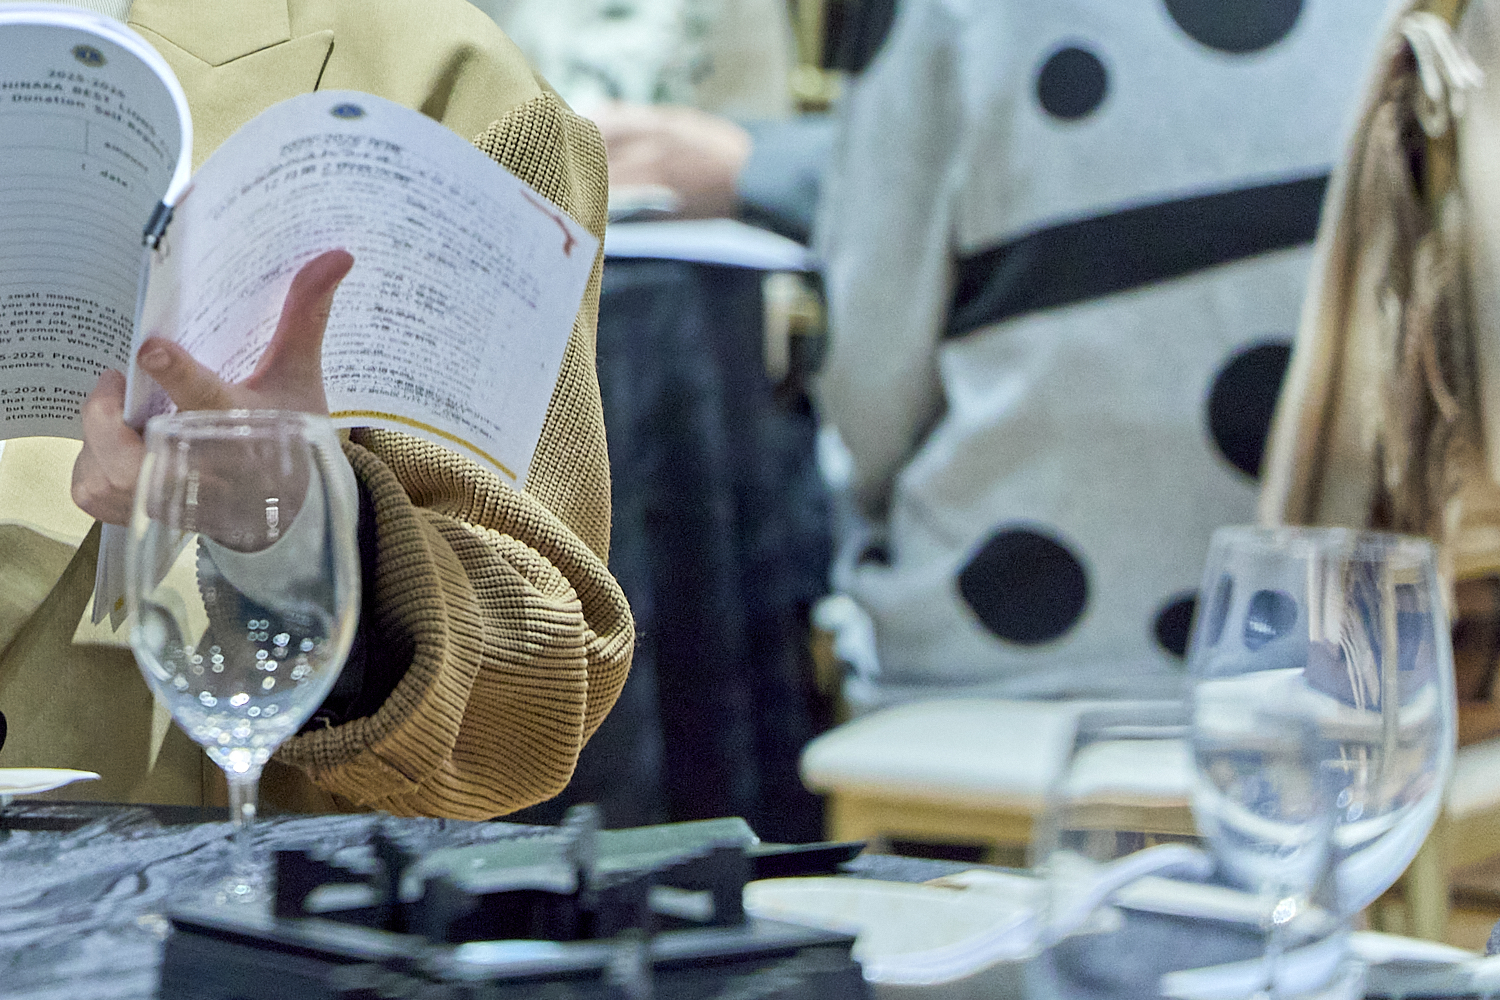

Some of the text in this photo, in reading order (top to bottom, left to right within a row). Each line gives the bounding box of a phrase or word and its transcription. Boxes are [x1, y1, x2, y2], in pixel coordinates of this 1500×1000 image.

[11, 93, 85, 108] Donation
[8, 291, 40, 300] small
[45, 292, 99, 309] moments
[1, 302, 23, 310] you
[29, 301, 80, 311] assumed
[13, 309, 46, 317] letter
[52, 310, 65, 318] of
[10, 318, 30, 327] got
[77, 322, 116, 341] passed
[16, 326, 74, 336] promoted
[92, 335, 115, 348] new
[18, 334, 26, 342] a
[32, 334, 61, 342] club.
[67, 336, 99, 350] When
[61, 362, 88, 373] then
[1, 395, 26, 406] that
[32, 395, 81, 406] deepens
[5, 404, 25, 413] but
[5, 412, 74, 421] atmosphere
